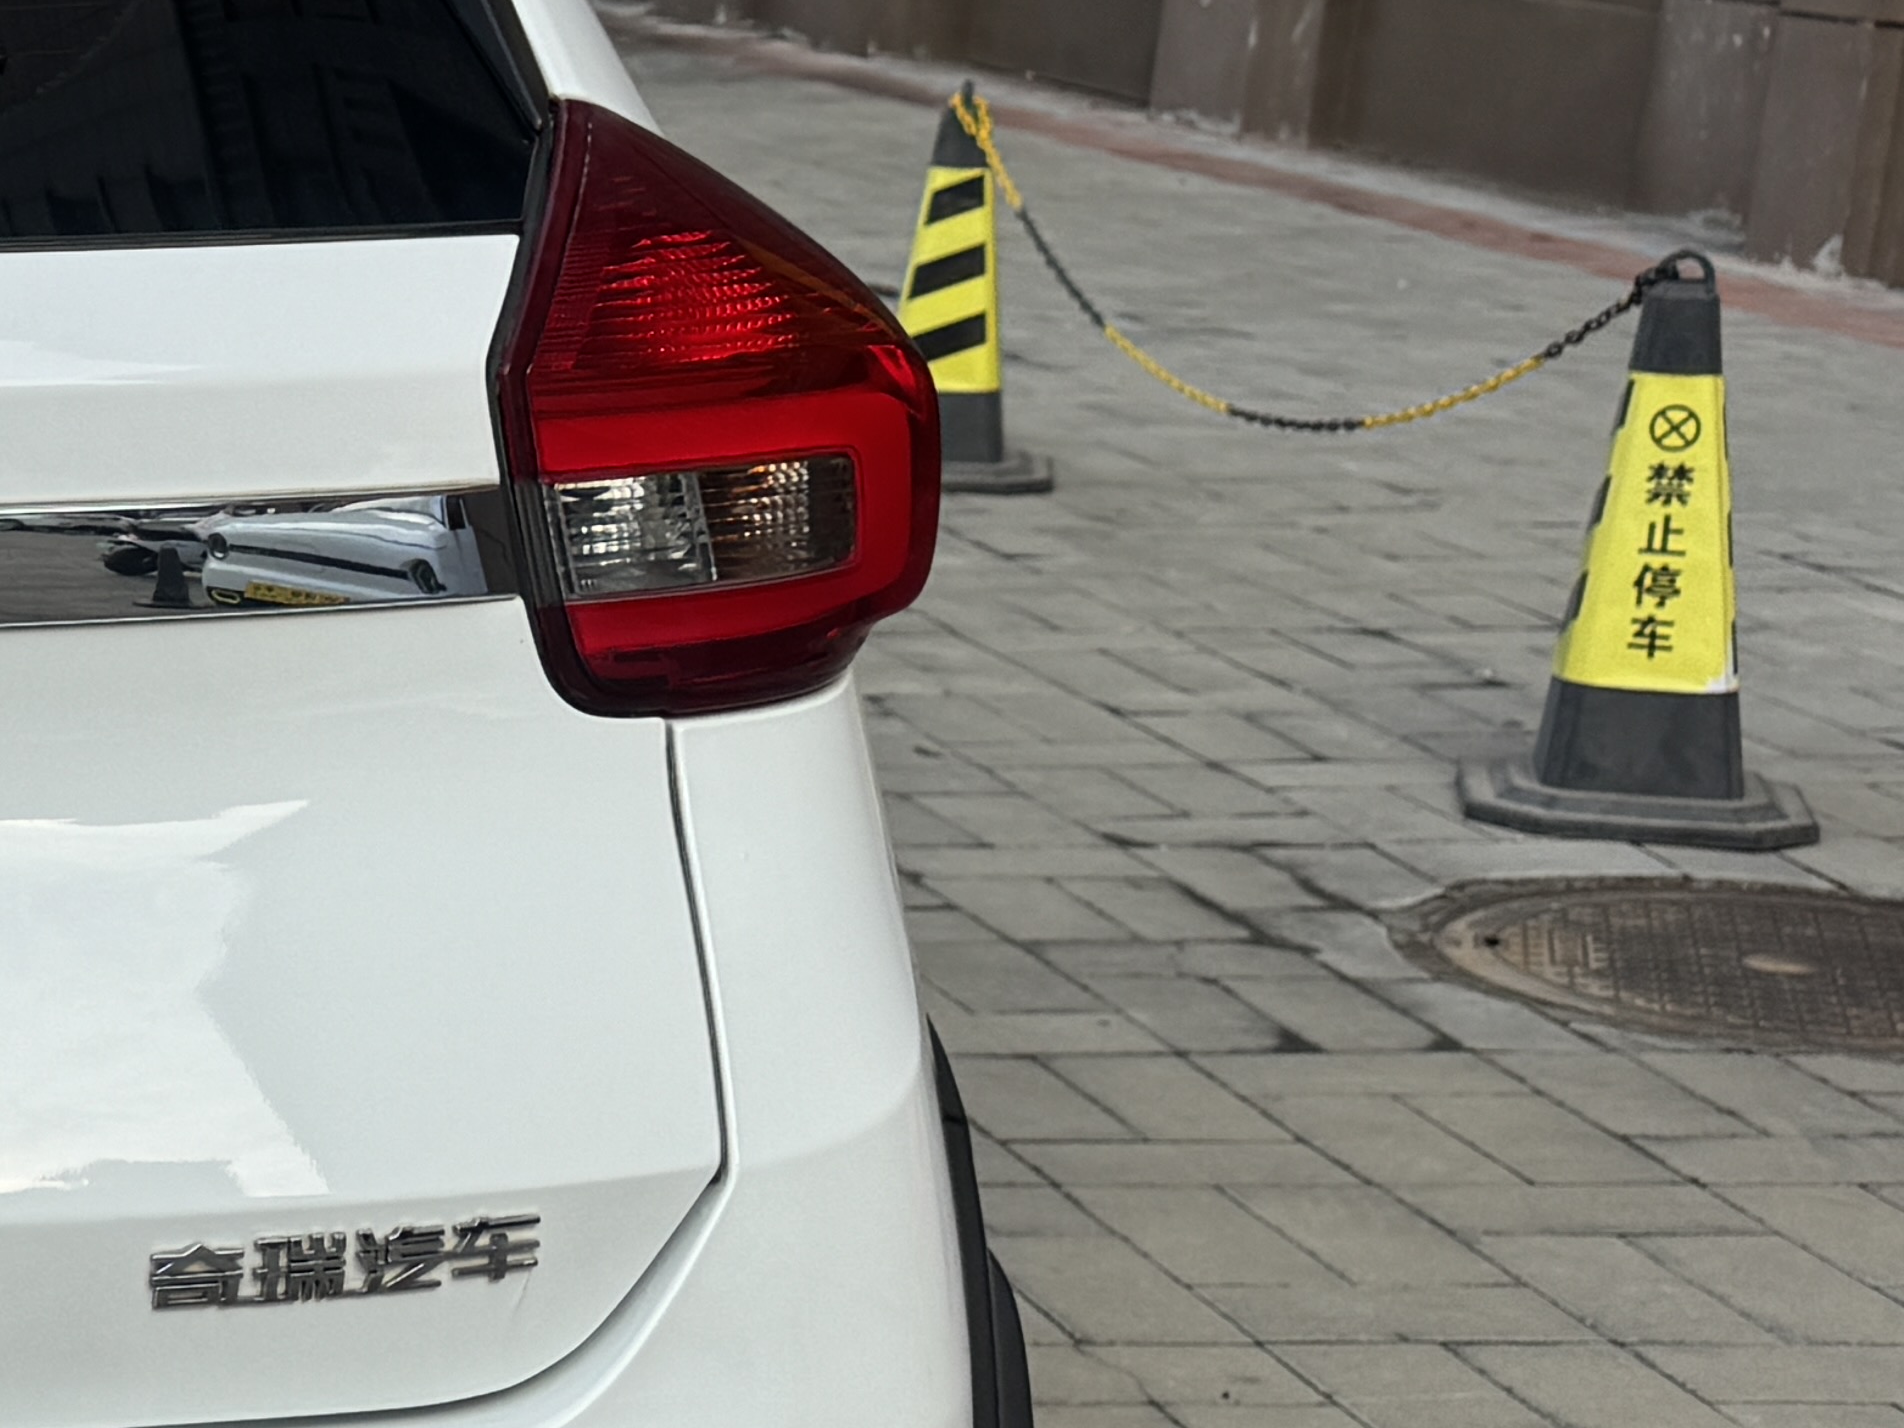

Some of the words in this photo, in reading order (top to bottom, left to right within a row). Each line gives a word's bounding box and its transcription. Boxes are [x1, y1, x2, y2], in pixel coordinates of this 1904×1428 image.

[1627, 462, 1694, 659] 禁止停车
[148, 1215, 541, 1310] 奇瑞汽车
